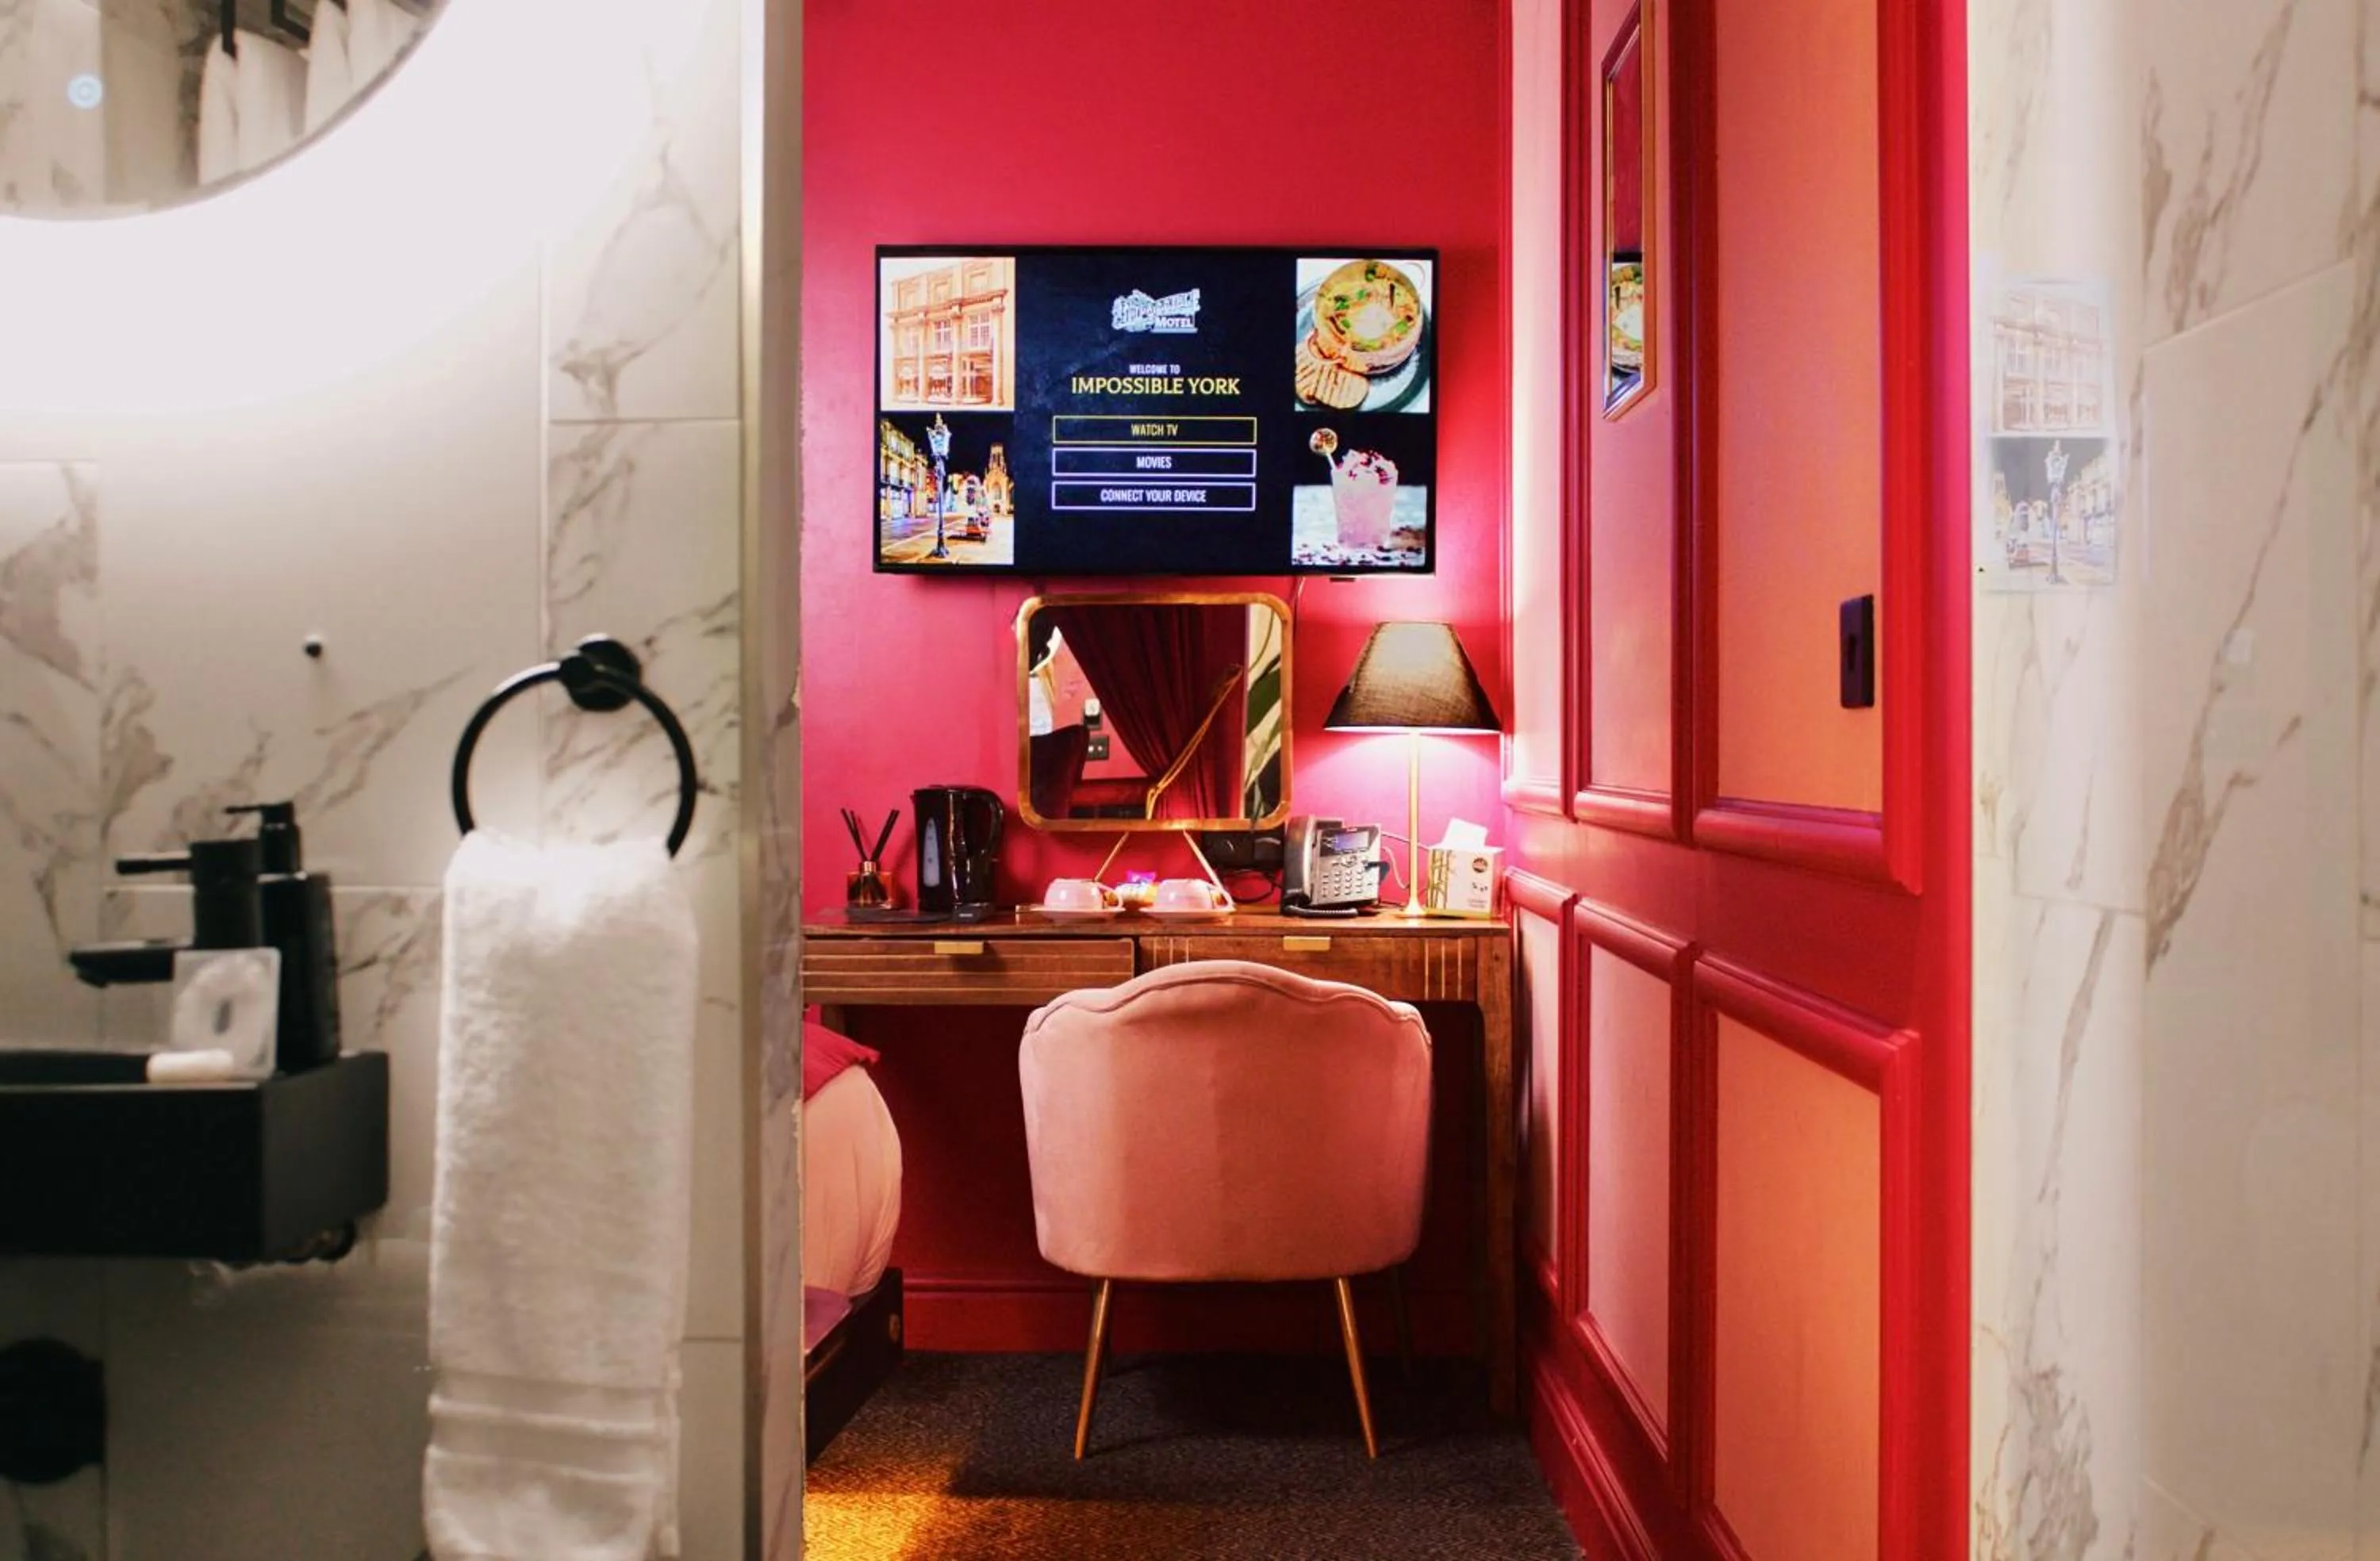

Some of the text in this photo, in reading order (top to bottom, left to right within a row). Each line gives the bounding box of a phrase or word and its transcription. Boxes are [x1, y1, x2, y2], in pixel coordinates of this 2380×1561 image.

[1155, 316, 1193, 328] MOTEL
[1129, 364, 1180, 374] WELCOME TO
[1072, 377, 1241, 395] IMPOSSIBLE YORK
[1130, 423, 1178, 436] WATCH TV
[1136, 456, 1172, 469] MOVIES
[1100, 489, 1206, 502] CONNECT YOUR DEVICE
